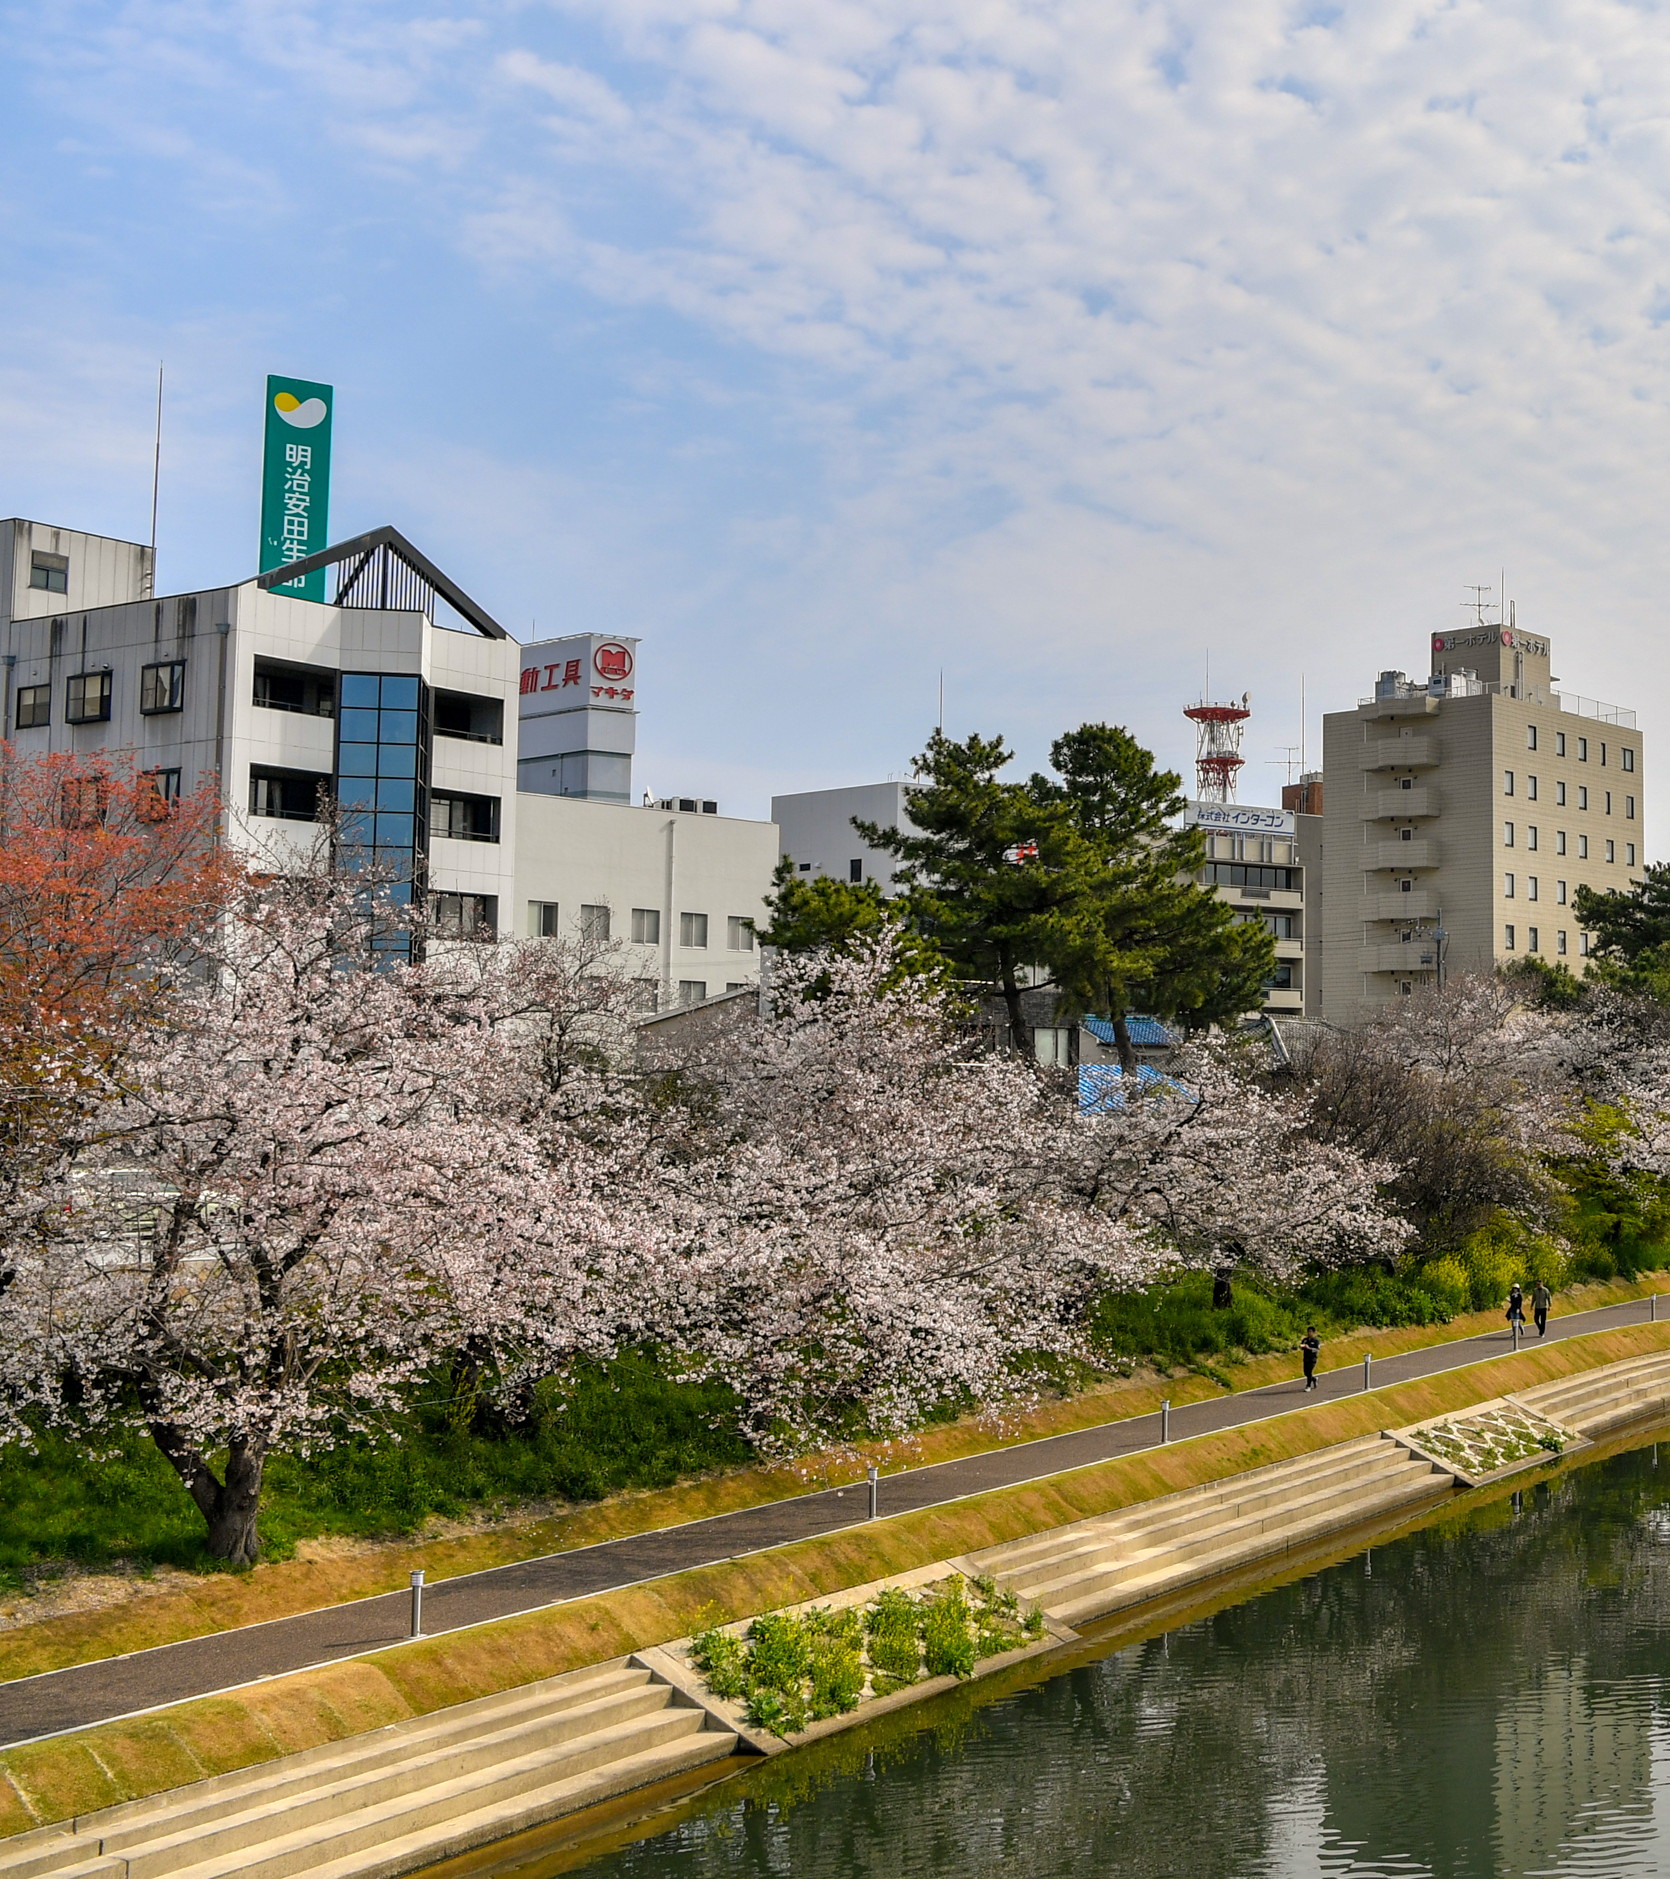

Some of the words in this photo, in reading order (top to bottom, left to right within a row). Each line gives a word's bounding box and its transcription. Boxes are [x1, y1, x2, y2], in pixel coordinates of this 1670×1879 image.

[1443, 631, 1498, 651] 第一ホテル
[1510, 632, 1550, 656] 第一ホテル
[589, 686, 635, 701] マキタ
[1196, 809, 1284, 828] 株式会社インターコン
